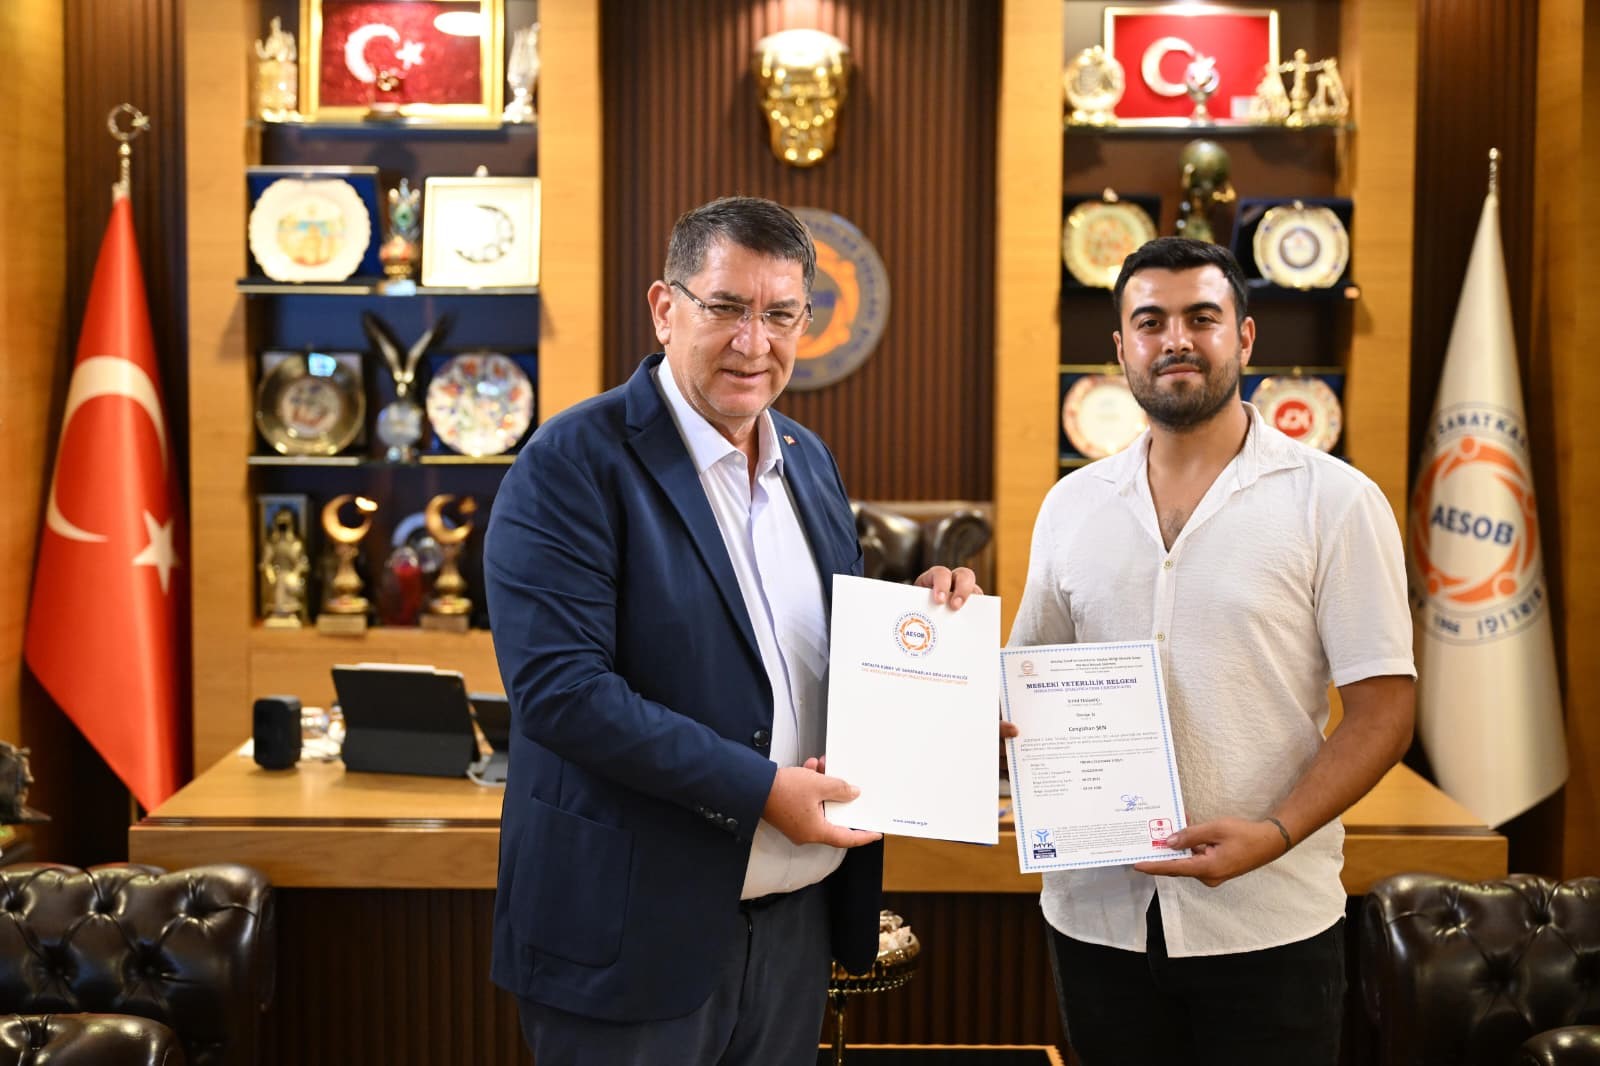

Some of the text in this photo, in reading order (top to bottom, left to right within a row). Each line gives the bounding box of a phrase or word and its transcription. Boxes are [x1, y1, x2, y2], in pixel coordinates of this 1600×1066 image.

[1430, 504, 1515, 546] AESOB
[905, 630, 925, 638] AESOB
[1026, 677, 1137, 689] MESLEKİ YETERLİLİK BELGESİ
